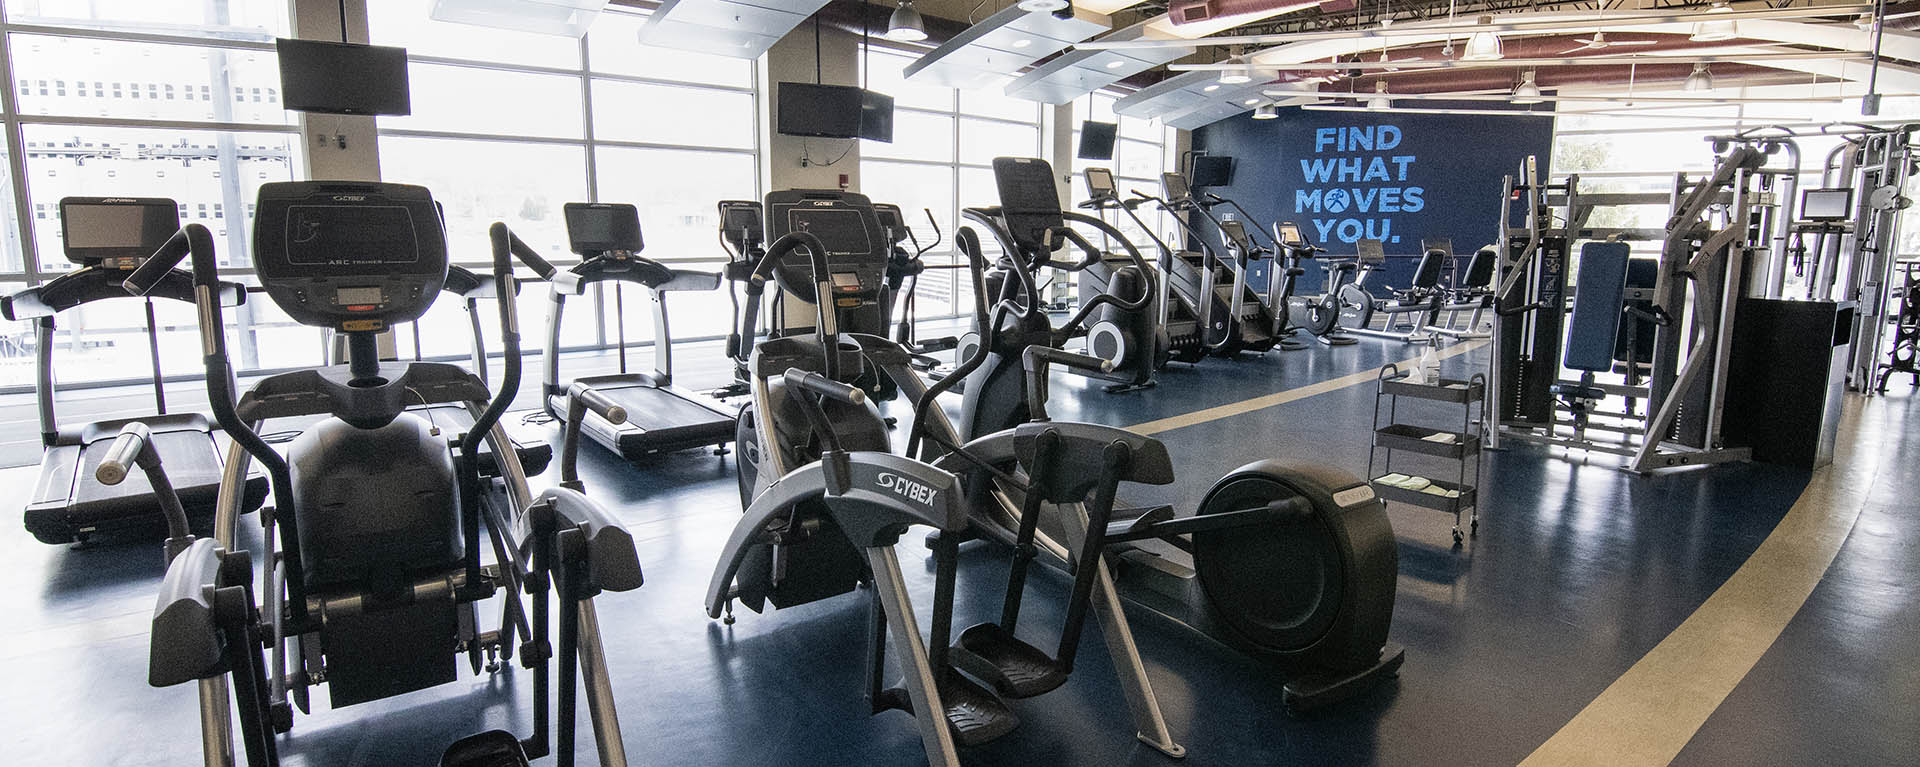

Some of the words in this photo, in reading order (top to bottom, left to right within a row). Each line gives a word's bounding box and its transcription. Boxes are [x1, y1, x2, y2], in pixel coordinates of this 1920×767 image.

[1315, 125, 1402, 152] FIND
[1300, 156, 1416, 183] WHAT
[1295, 187, 1425, 213] MOVES
[1312, 218, 1401, 243] YOU.
[894, 476, 937, 507] CYBEX
